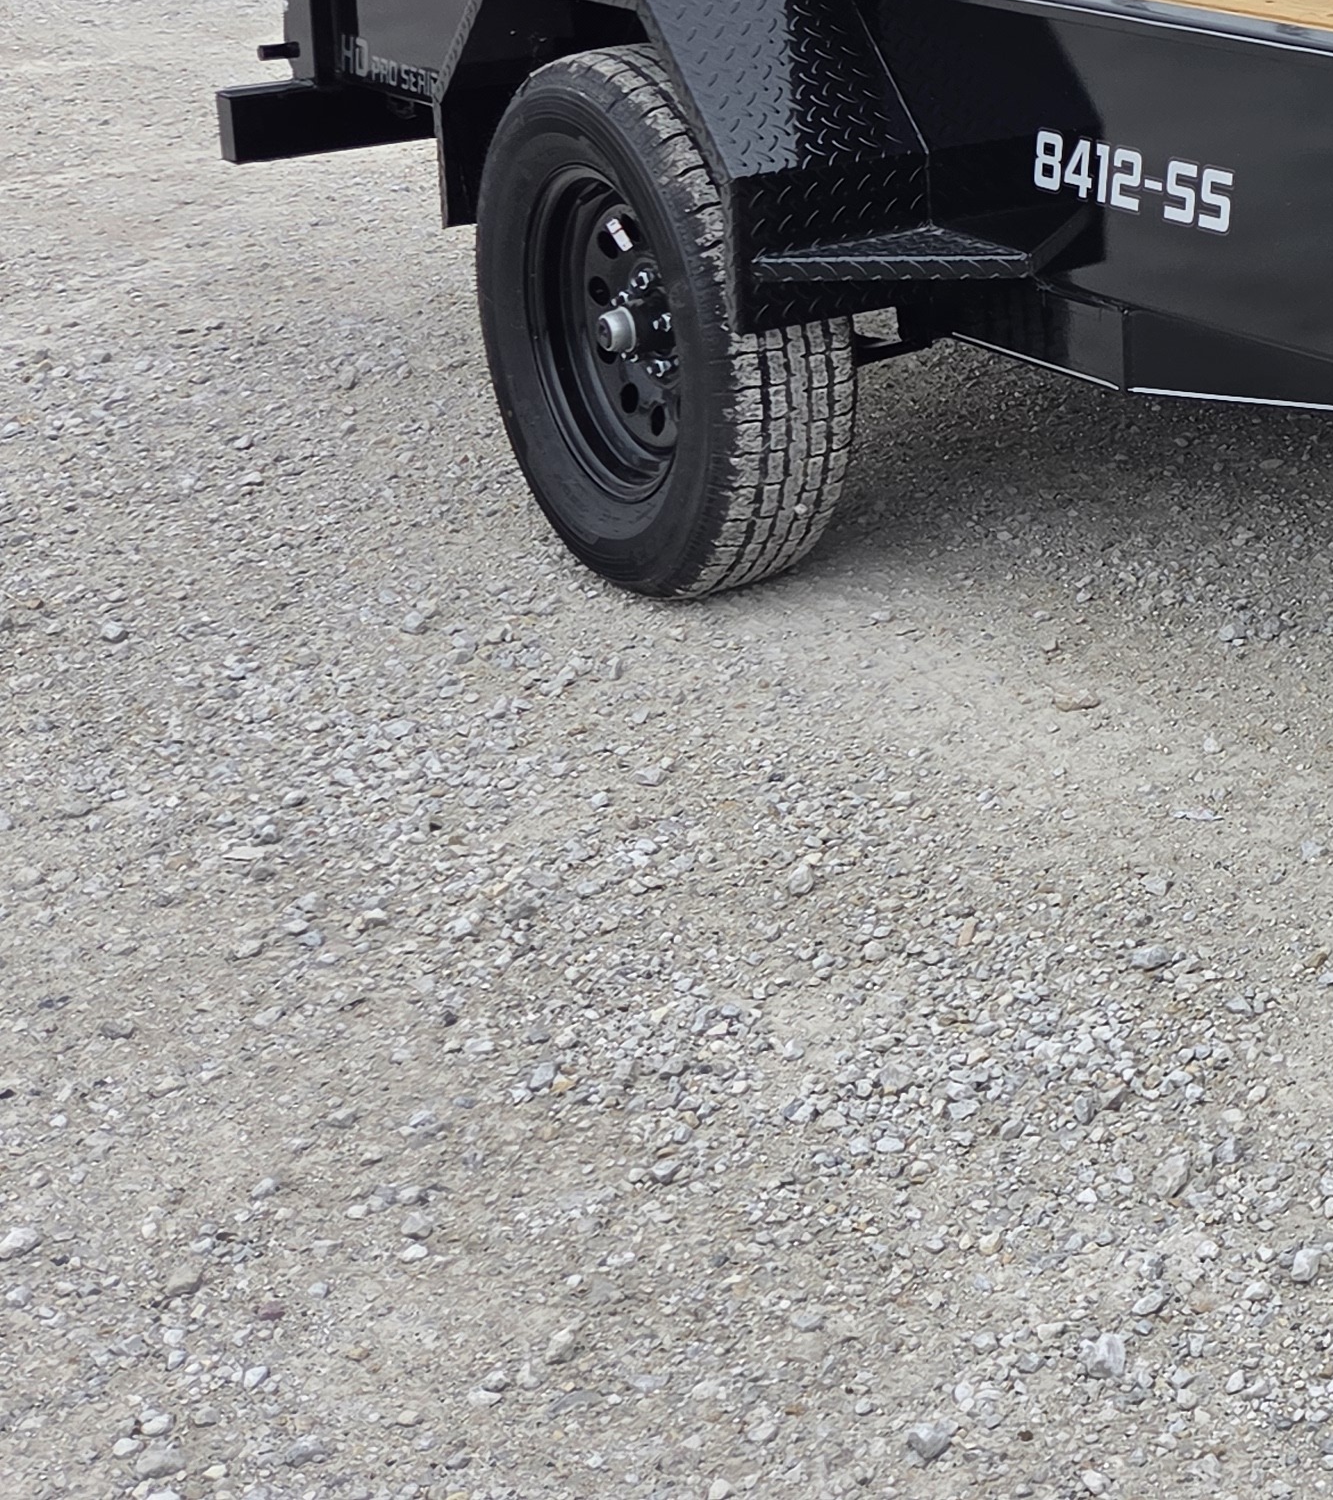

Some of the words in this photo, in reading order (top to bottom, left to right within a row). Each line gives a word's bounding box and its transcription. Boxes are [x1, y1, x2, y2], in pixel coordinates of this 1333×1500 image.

[341, 34, 369, 77] HD
[371, 55, 398, 87] PRO
[1033, 130, 1234, 233] 8412-SS
